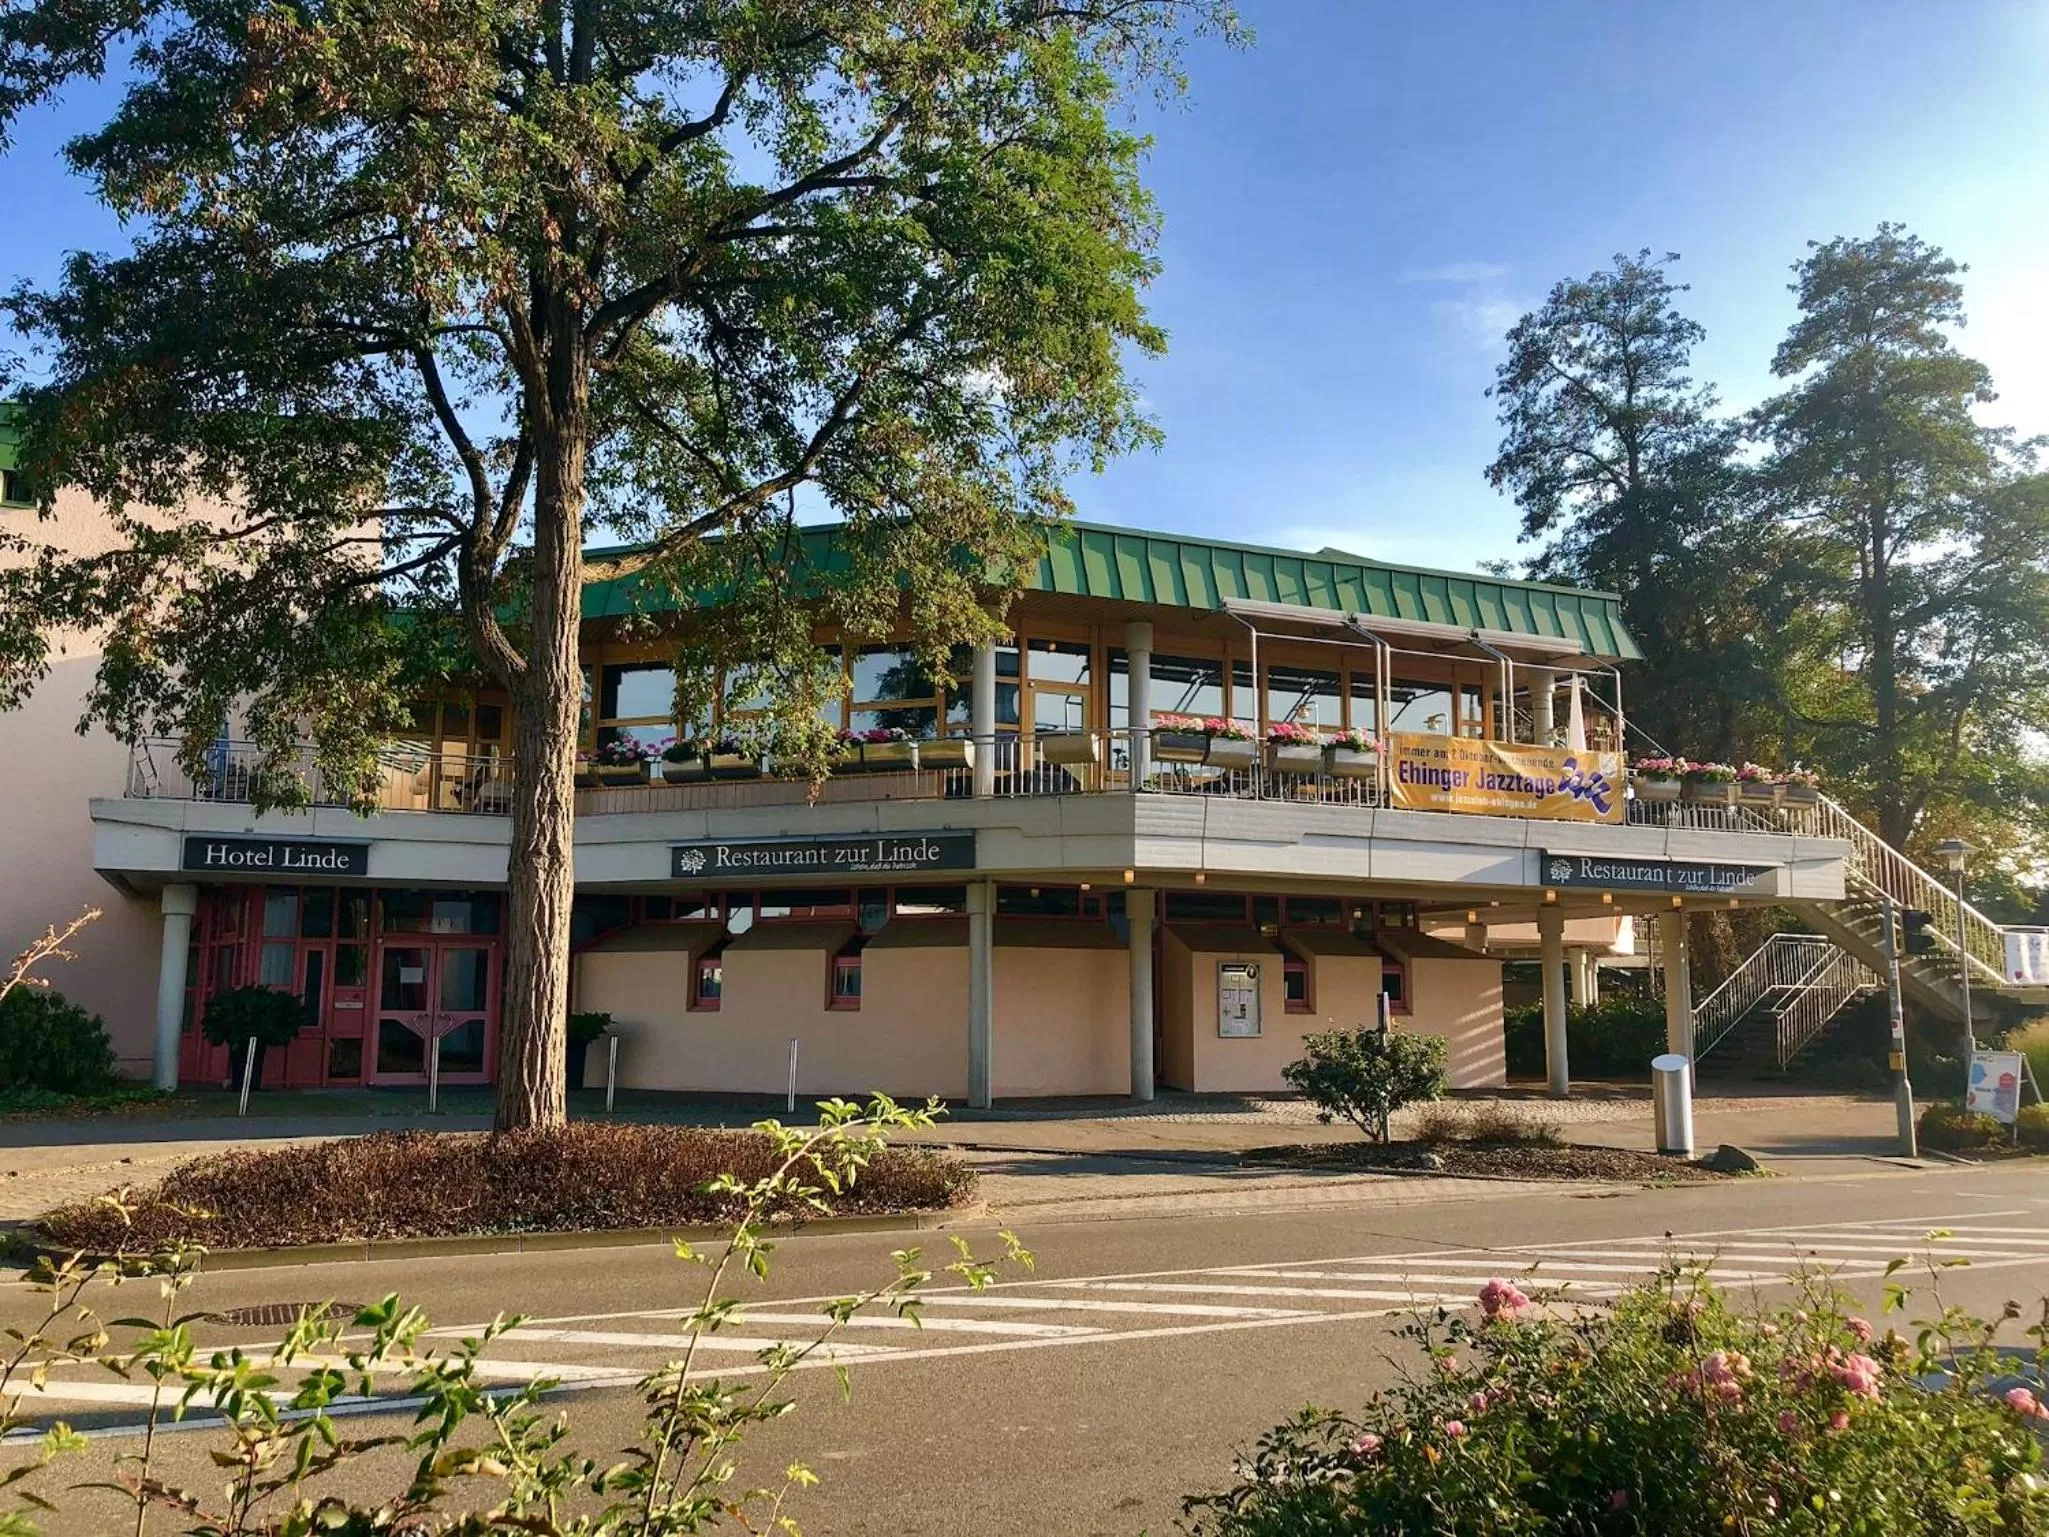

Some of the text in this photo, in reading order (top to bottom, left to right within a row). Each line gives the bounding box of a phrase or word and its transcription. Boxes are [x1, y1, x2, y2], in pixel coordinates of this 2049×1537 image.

[1399, 760, 1469, 790] Ehinger
[1476, 767, 1555, 799] Jazztage
[204, 844, 350, 869] Hotel Linde
[716, 846, 828, 867] Restaurant
[835, 845, 869, 863] zur
[877, 838, 940, 862] Linde
[1580, 859, 1755, 887] Restaurant zur Linde
